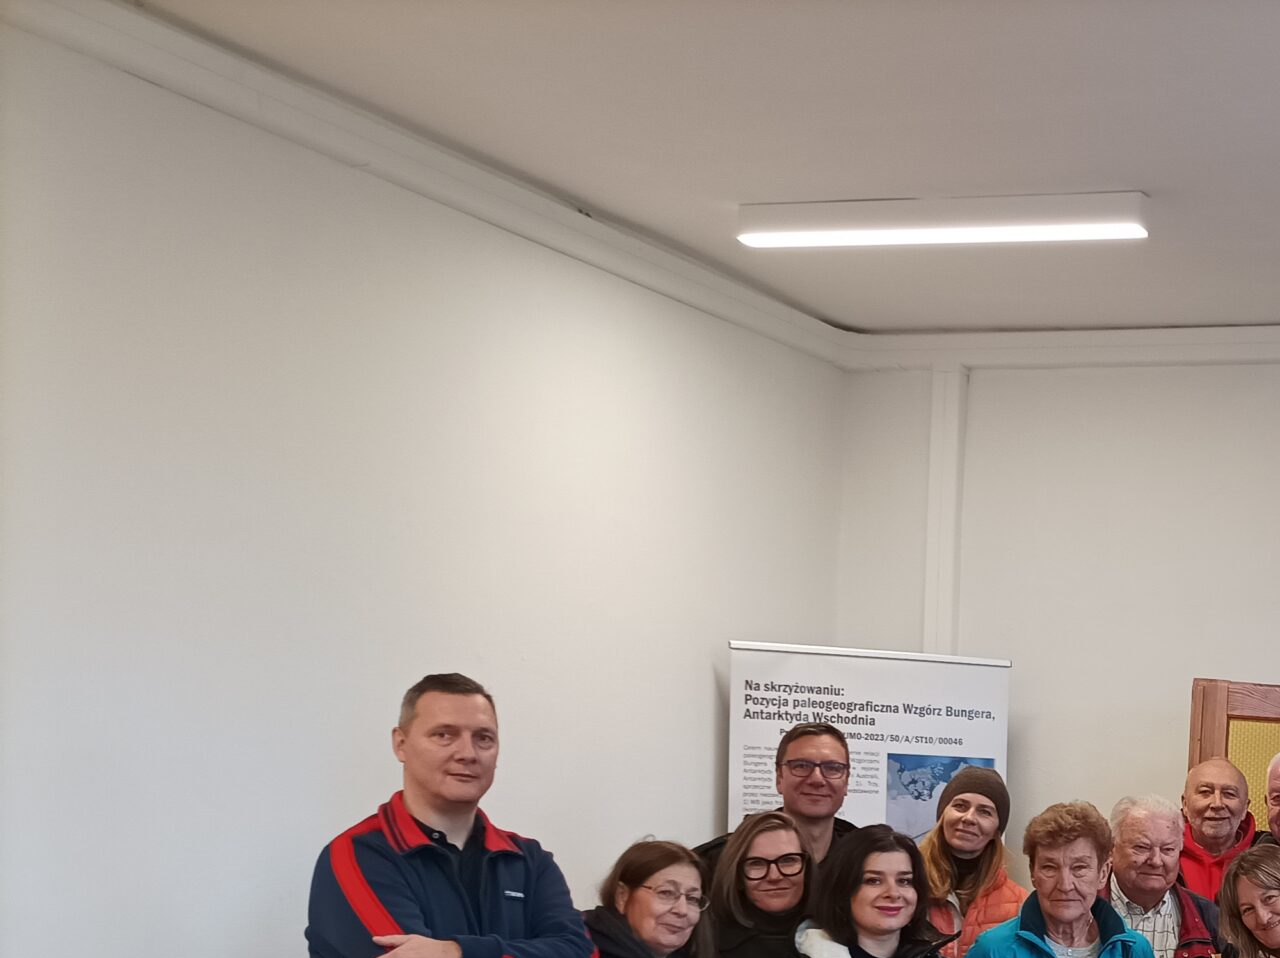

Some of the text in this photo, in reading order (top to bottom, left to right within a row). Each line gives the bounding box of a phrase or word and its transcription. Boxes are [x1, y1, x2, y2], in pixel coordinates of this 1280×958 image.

[744, 680, 845, 697] Na skrzyżowaniu:
[744, 694, 996, 721] Pozycja paleogeograficzna Wzgórz Bungera,
[743, 709, 876, 727] Antarktyda Wschodnia
